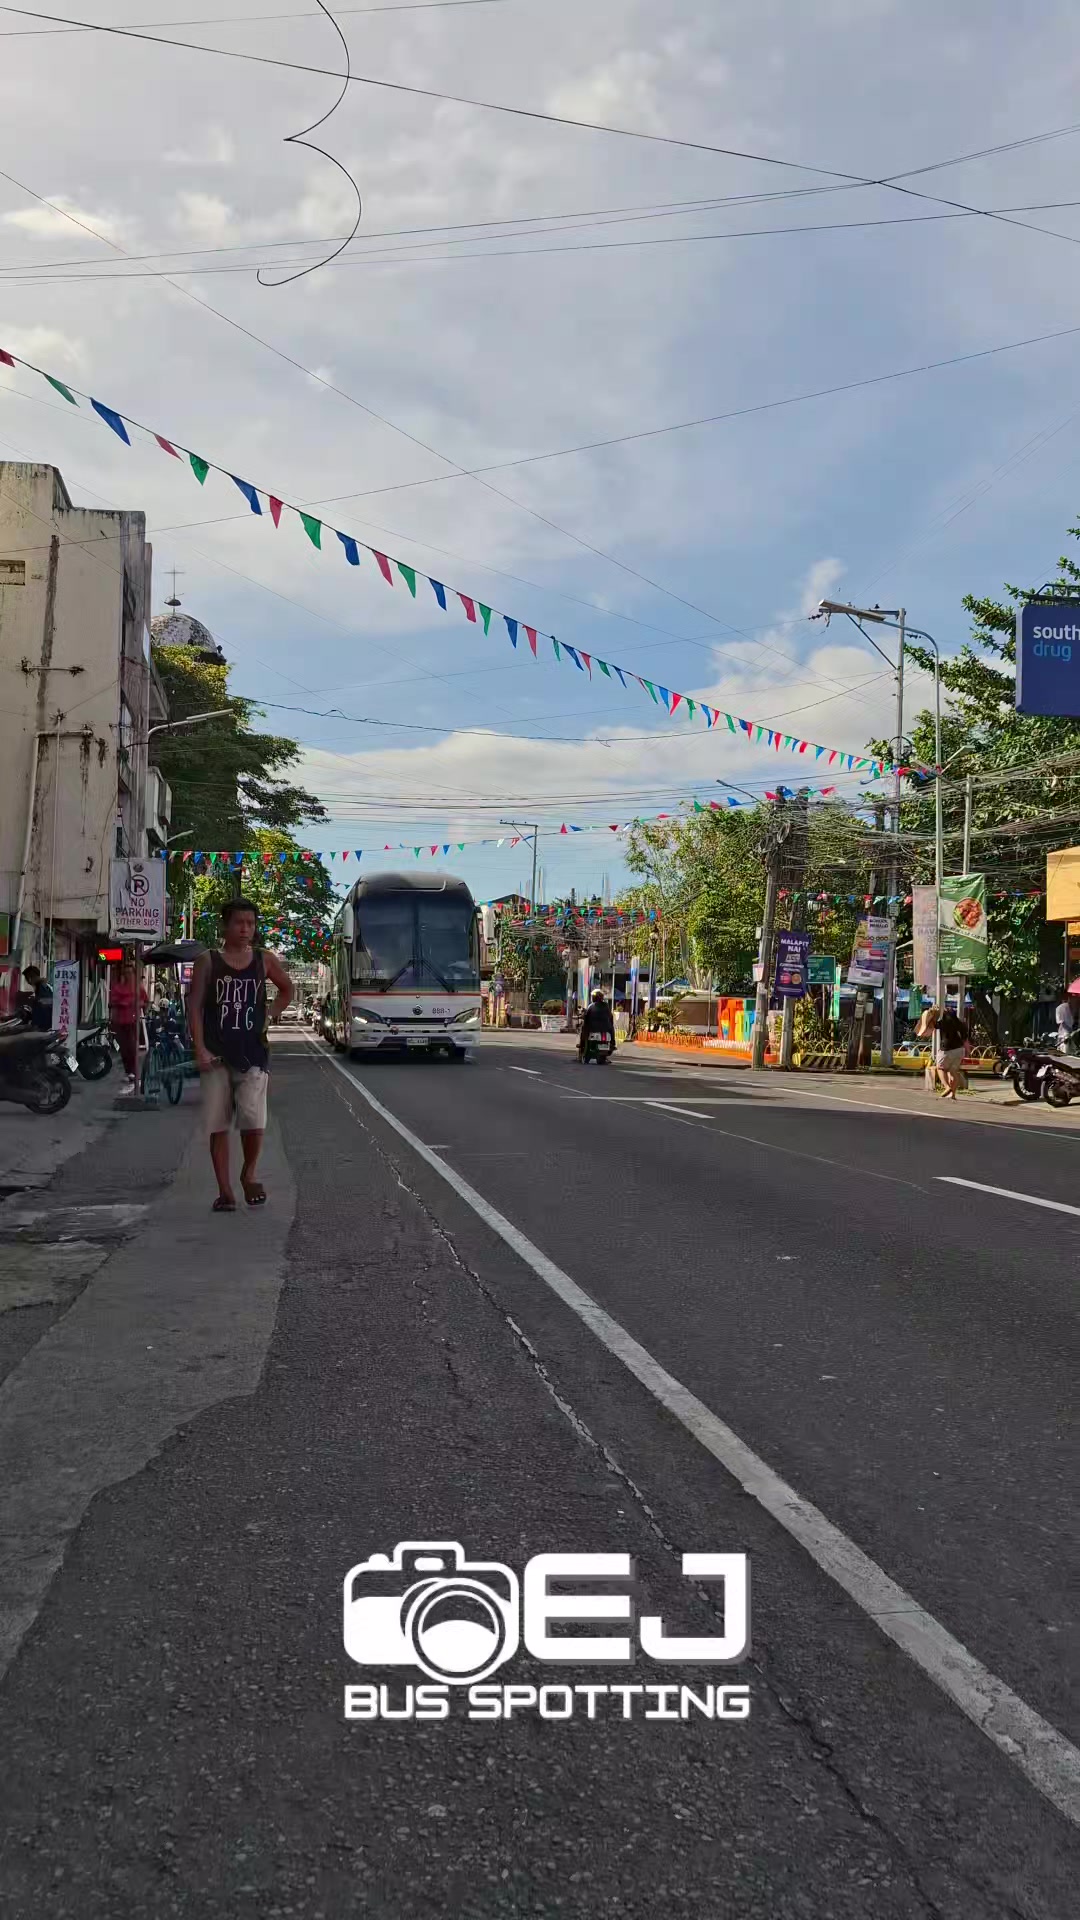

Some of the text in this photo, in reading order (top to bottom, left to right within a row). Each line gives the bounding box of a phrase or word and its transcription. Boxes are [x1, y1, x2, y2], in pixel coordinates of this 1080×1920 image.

[1033, 624, 1080, 641] south
[1033, 640, 1072, 662] drug
[130, 898, 146, 908] NO
[115, 907, 159, 918] PARKING
[116, 918, 160, 927] EITHER SIDE
[216, 975, 262, 1005] DIRTY
[220, 1002, 254, 1031] PIG
